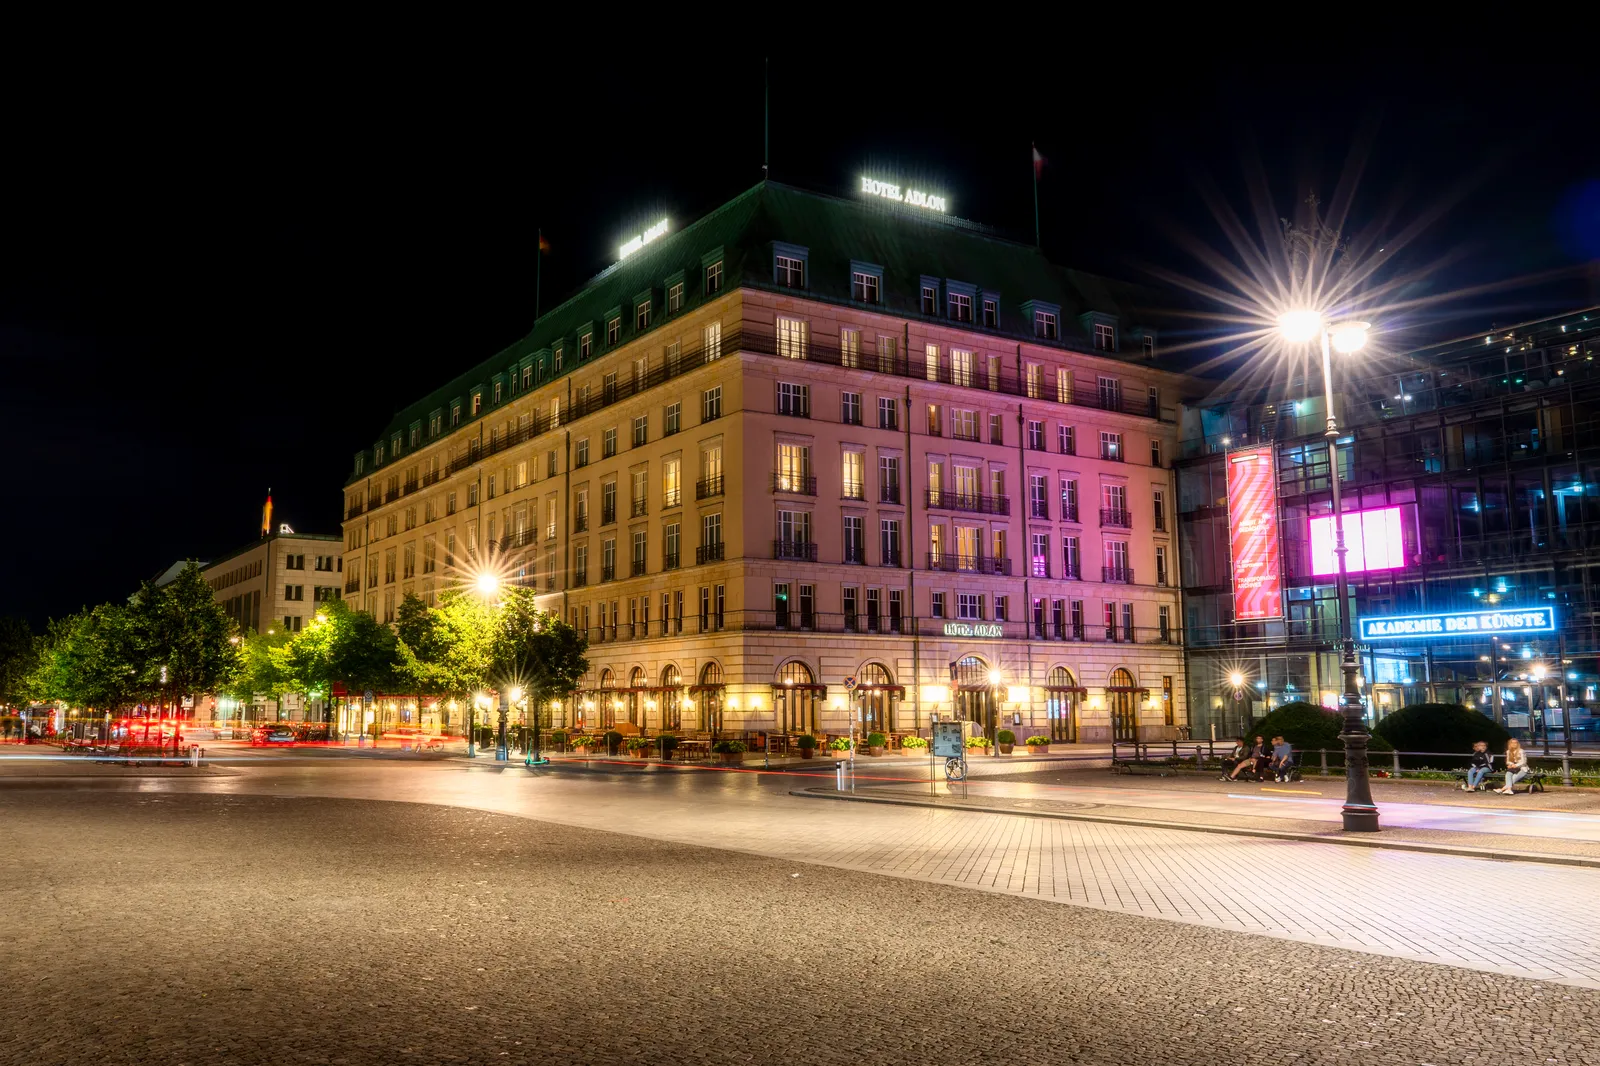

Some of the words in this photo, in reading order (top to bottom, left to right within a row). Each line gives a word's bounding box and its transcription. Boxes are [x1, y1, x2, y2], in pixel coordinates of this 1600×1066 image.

[861, 177, 903, 201] HOTEL
[904, 188, 946, 212] ADLON
[1367, 618, 1443, 635] AKADEMIE
[1445, 616, 1478, 631] DER
[1480, 612, 1546, 629] KÜNSTE
